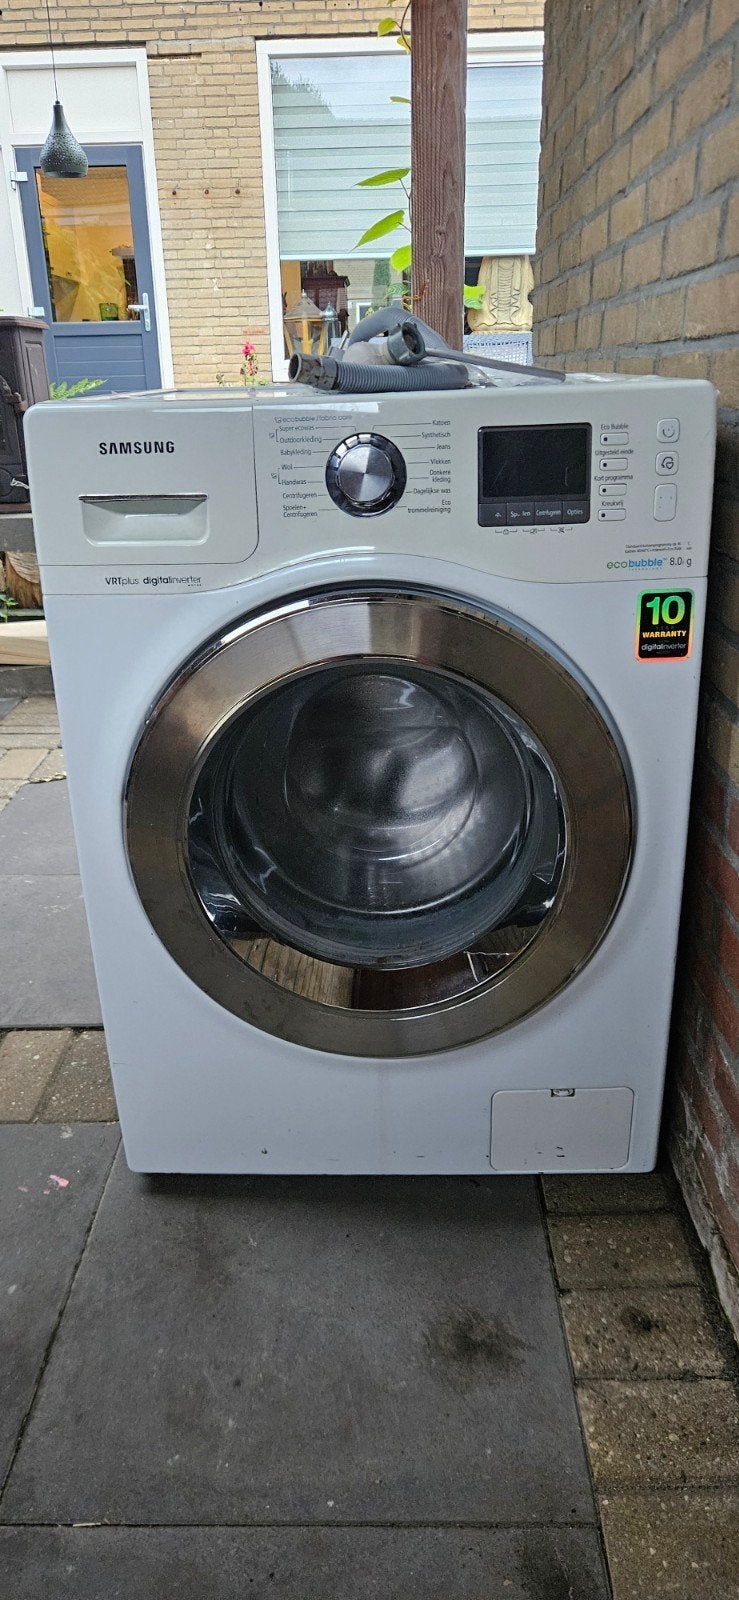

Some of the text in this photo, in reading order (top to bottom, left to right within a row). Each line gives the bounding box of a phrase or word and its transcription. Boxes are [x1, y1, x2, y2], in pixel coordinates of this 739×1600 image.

[99, 441, 175, 455] SAMSUNG
[105, 576, 138, 586] VRTplus
[646, 595, 686, 625] 10
